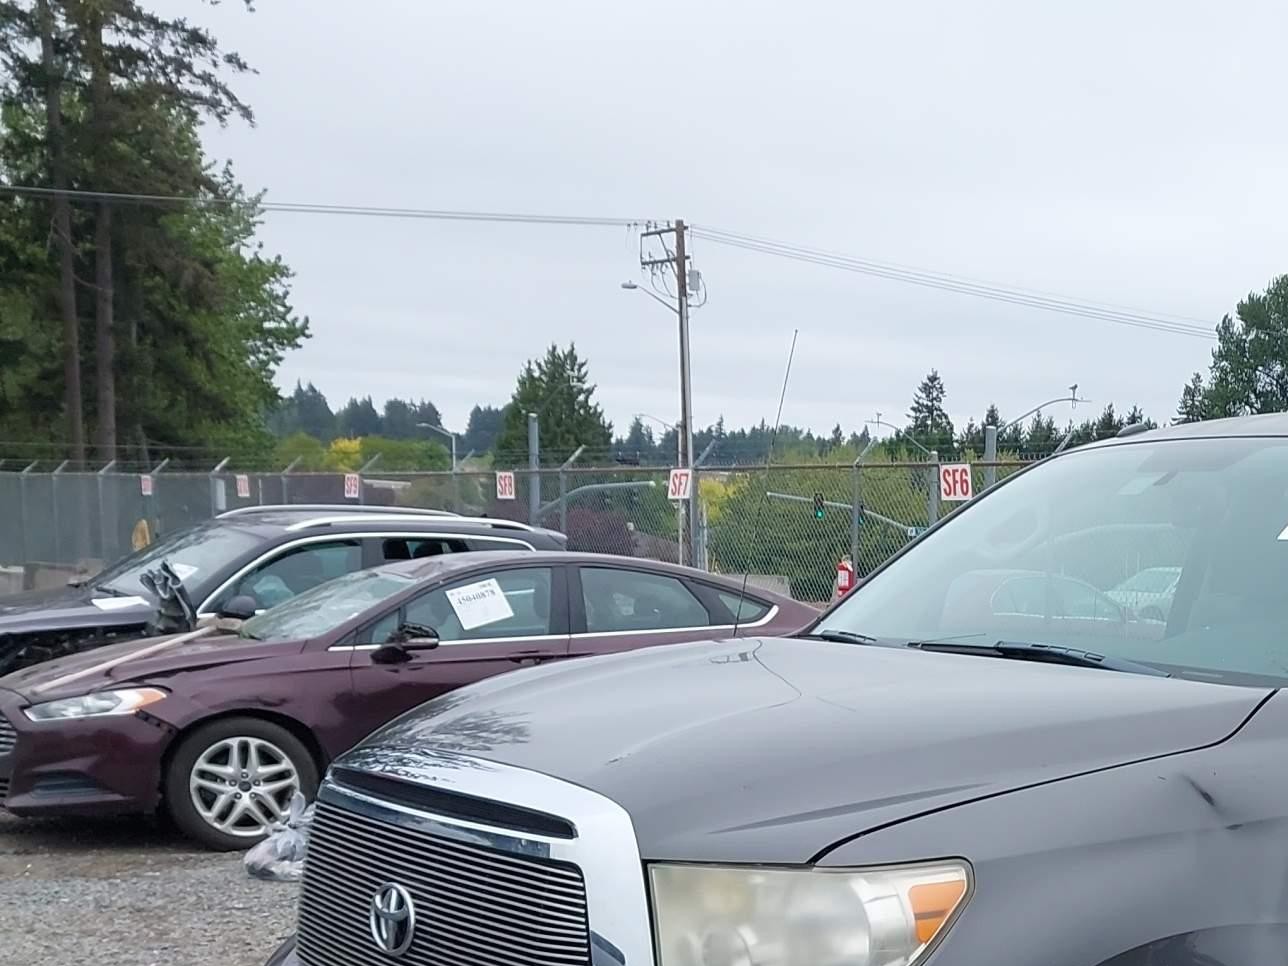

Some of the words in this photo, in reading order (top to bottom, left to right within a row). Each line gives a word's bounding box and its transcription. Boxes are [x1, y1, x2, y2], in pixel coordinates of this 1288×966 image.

[498, 474, 513, 496] SF8
[671, 473, 689, 496] SF7
[943, 468, 969, 497] SF6
